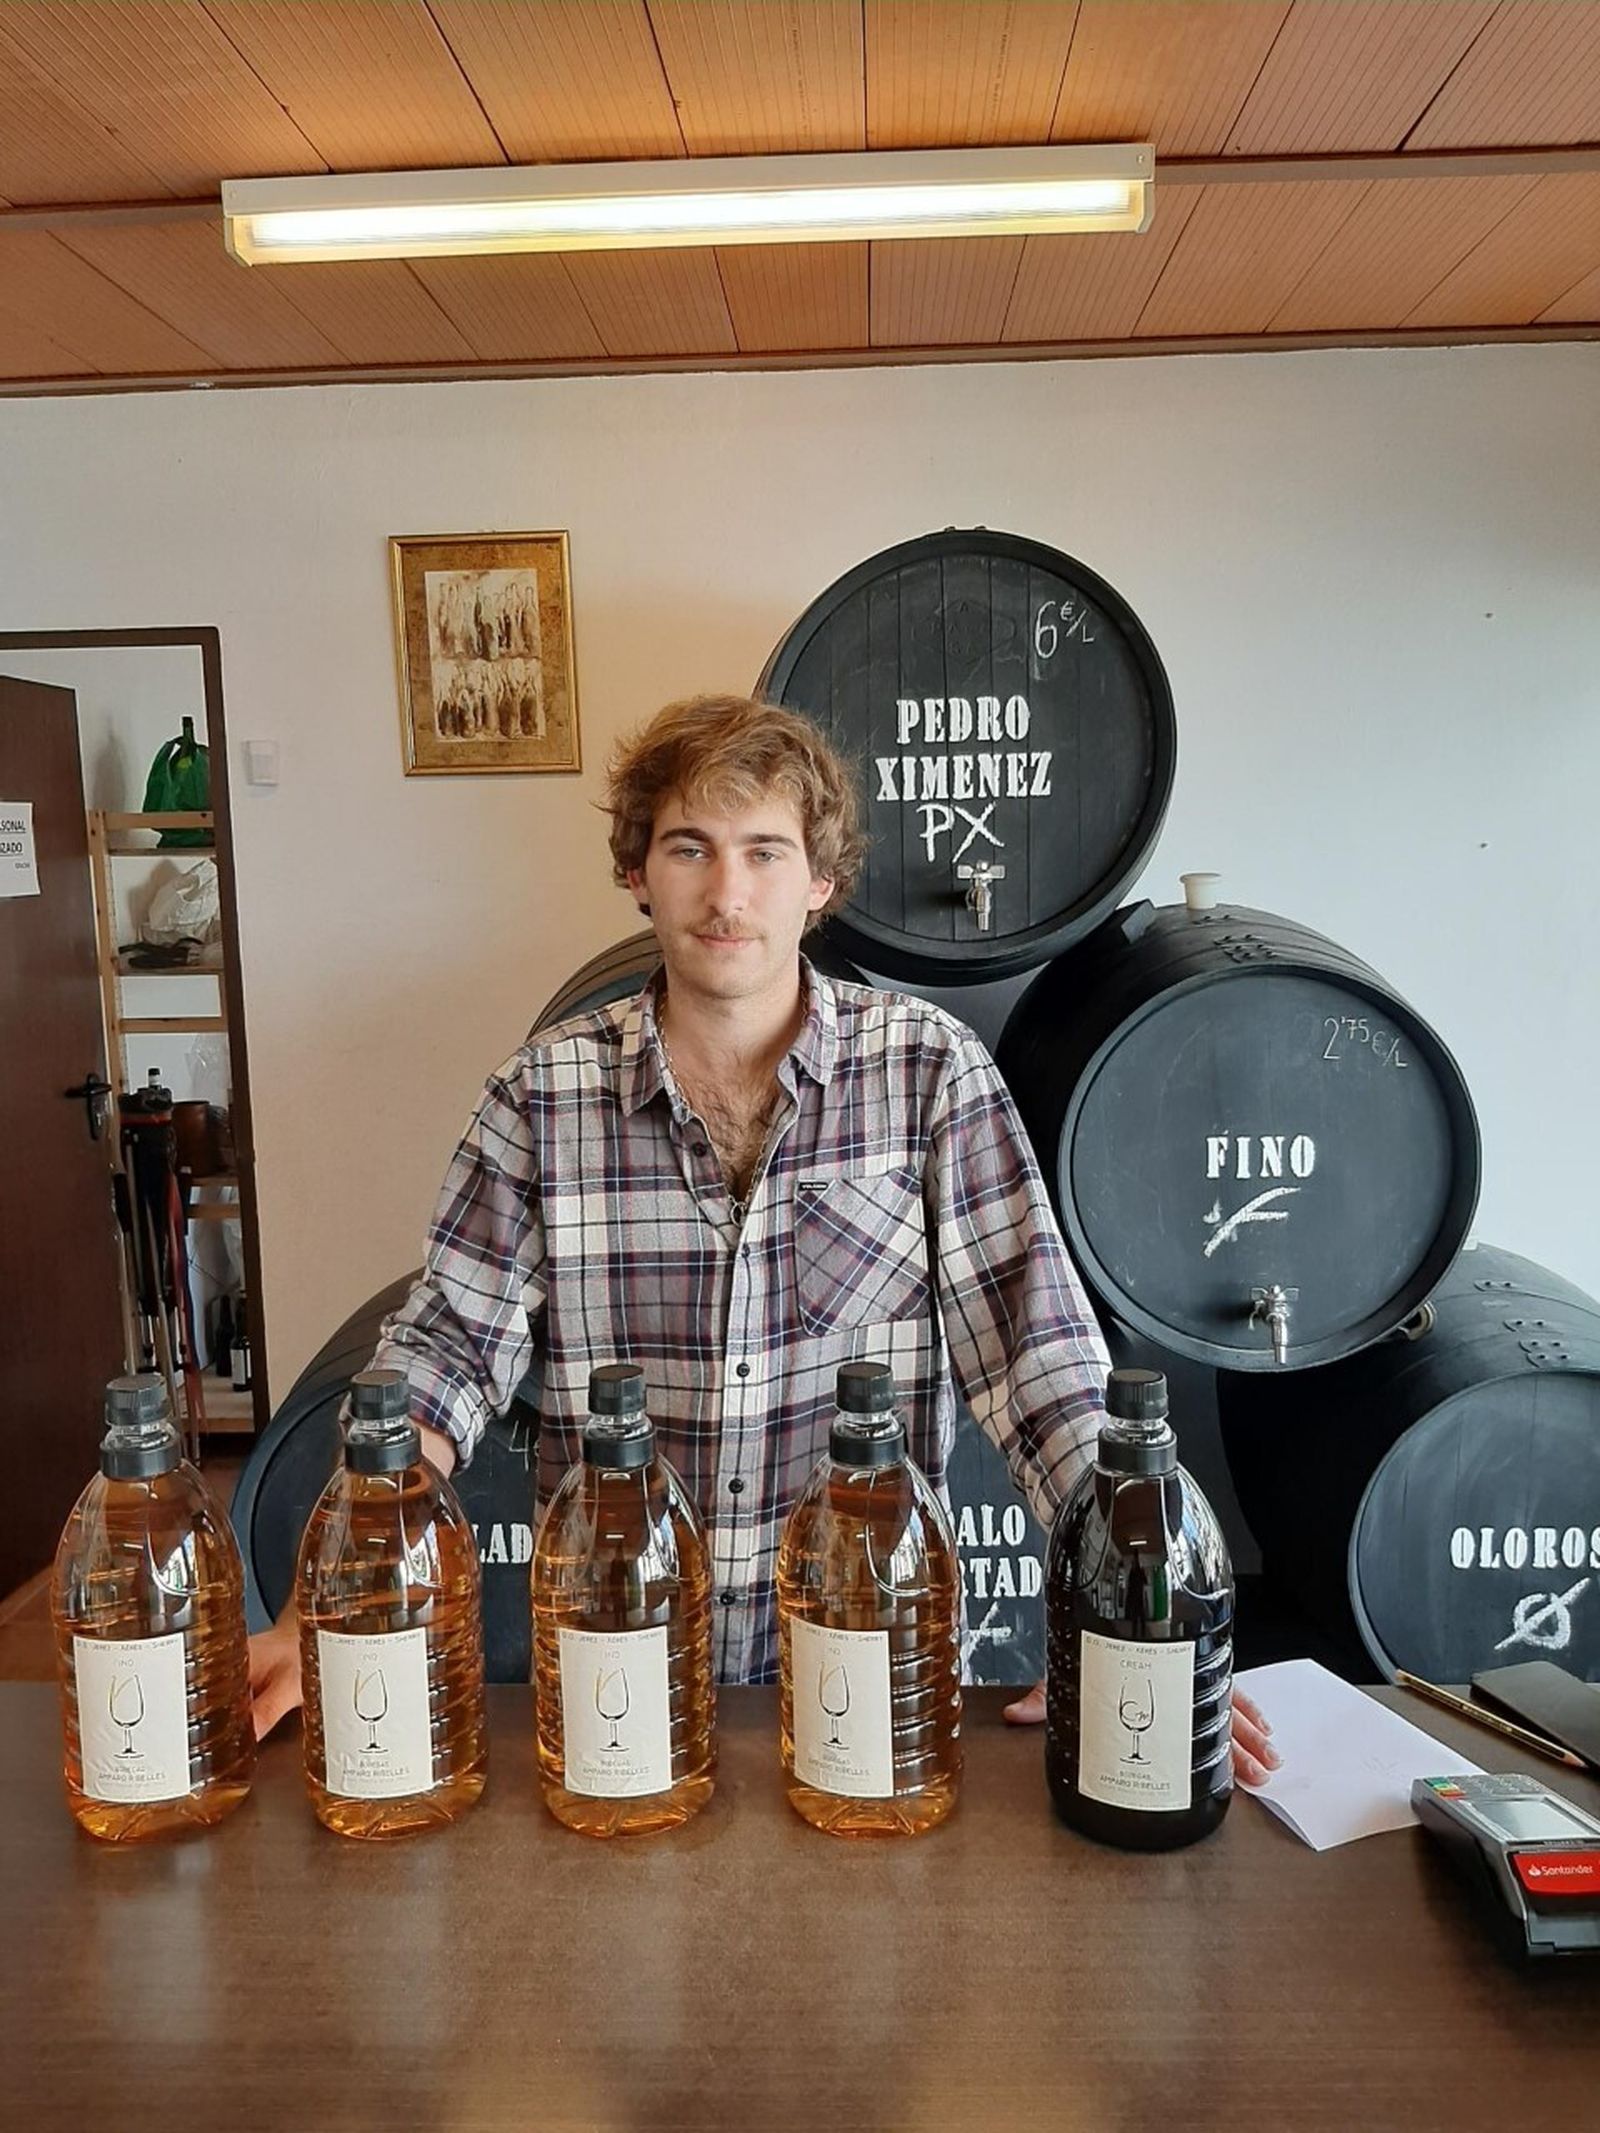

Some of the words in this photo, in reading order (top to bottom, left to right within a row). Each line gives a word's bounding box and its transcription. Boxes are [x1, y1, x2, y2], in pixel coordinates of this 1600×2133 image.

[896, 695, 1031, 744] PEDRO
[875, 751, 1052, 801] XIMENEZ
[916, 802, 1005, 863] PX
[1206, 1134, 1316, 1179] FINO
[953, 1503, 1026, 1547] ALO
[1450, 1527, 1600, 1569] OLOROS
[1541, 1865, 1593, 1877] Santander
